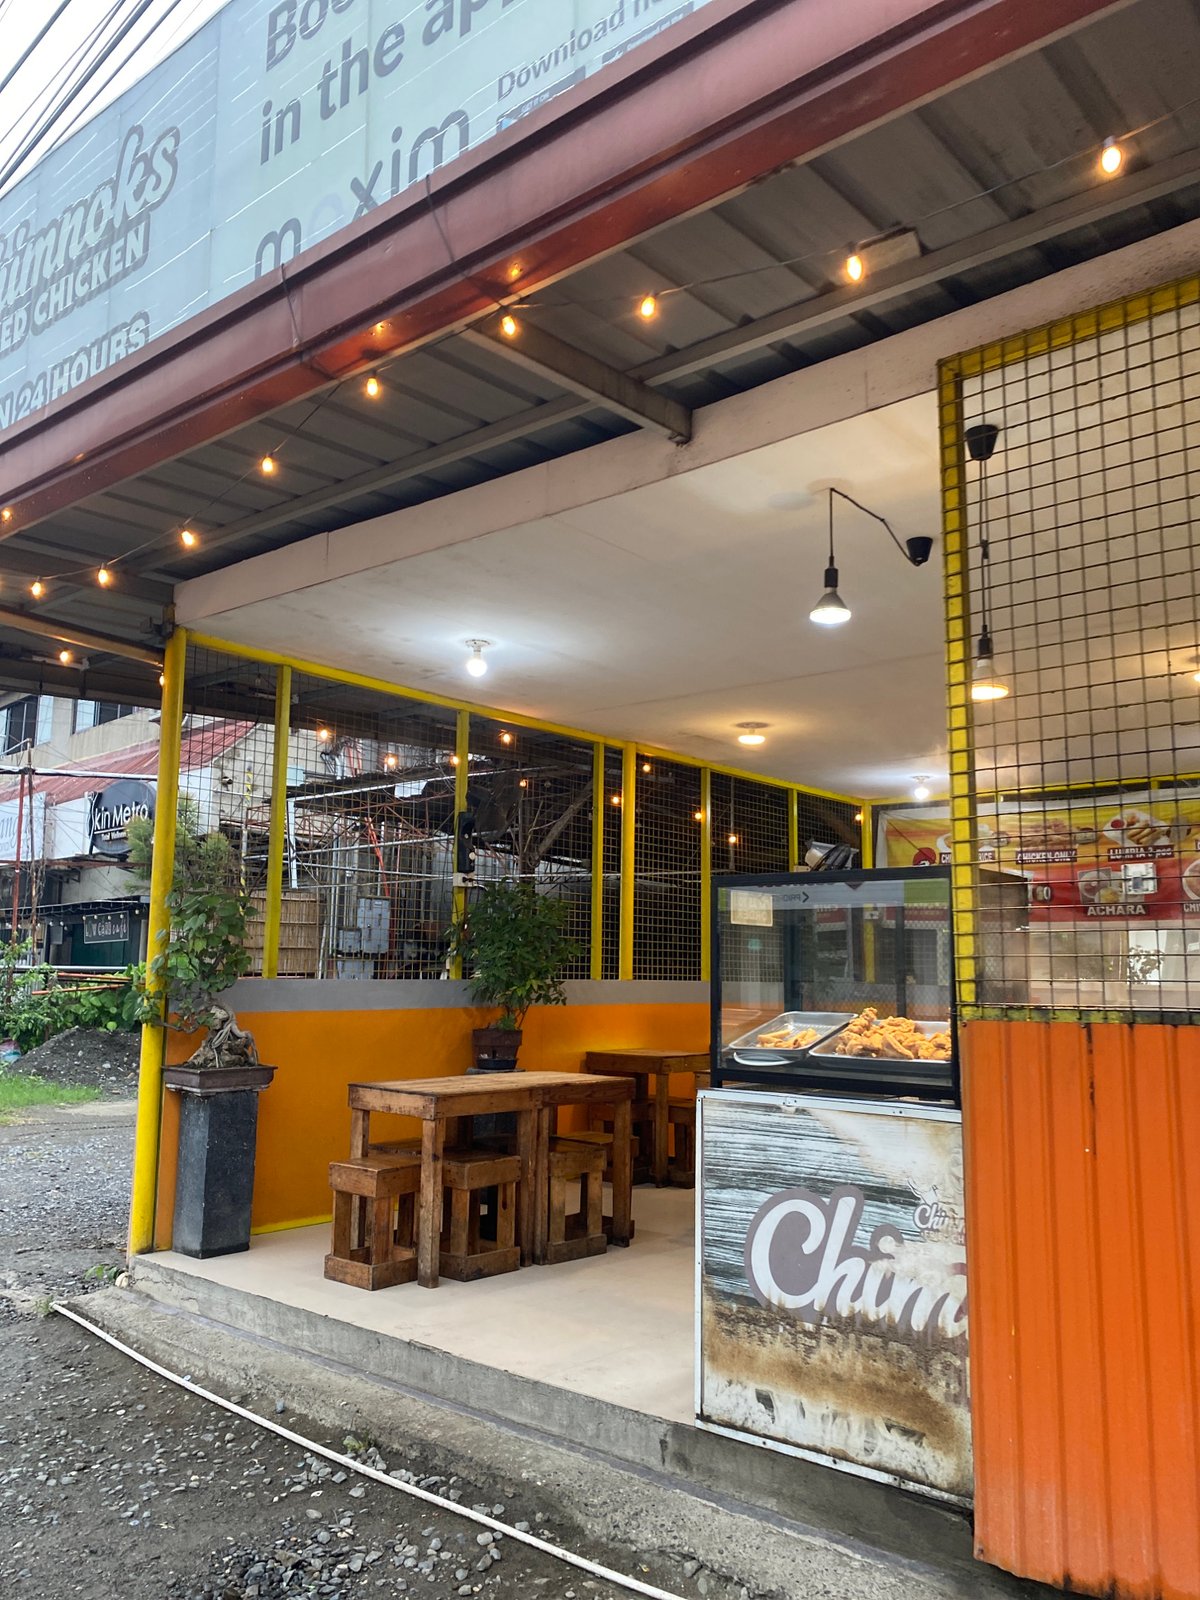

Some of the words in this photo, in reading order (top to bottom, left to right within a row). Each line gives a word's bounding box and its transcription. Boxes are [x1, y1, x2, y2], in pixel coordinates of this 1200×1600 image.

[497, 0, 625, 102] Download
[260, 98, 301, 166] in
[316, 21, 405, 121] the
[33, 220, 147, 326] CHICKEN
[16, 378, 46, 421] 24
[51, 315, 148, 400] HOURS
[112, 801, 149, 828] Metro
[1017, 852, 1053, 863] CHICKEN
[1054, 850, 1076, 862] ONLY
[1109, 847, 1146, 860] LUMPIA
[1087, 904, 1146, 916] ACHARA
